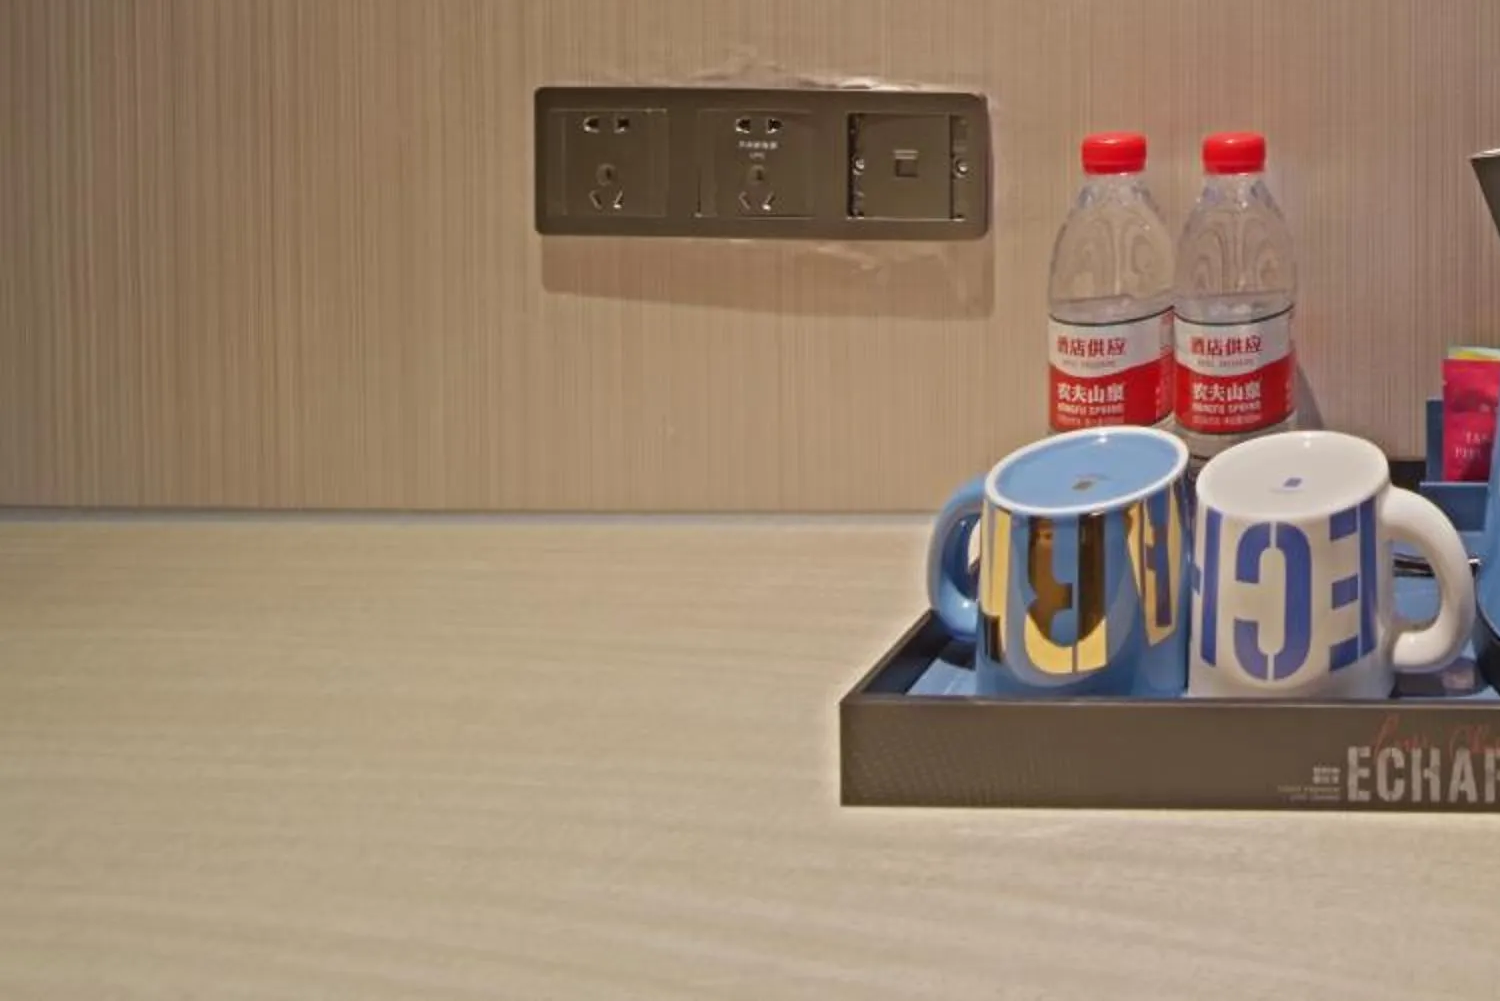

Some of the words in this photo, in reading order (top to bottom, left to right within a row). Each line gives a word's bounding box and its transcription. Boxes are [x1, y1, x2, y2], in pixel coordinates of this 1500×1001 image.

[1056, 335, 1127, 356] 酒店供应
[1190, 335, 1263, 355] 酒店供应
[1057, 383, 1125, 403] 农夫山泉
[1192, 381, 1262, 402] 农夫山泉
